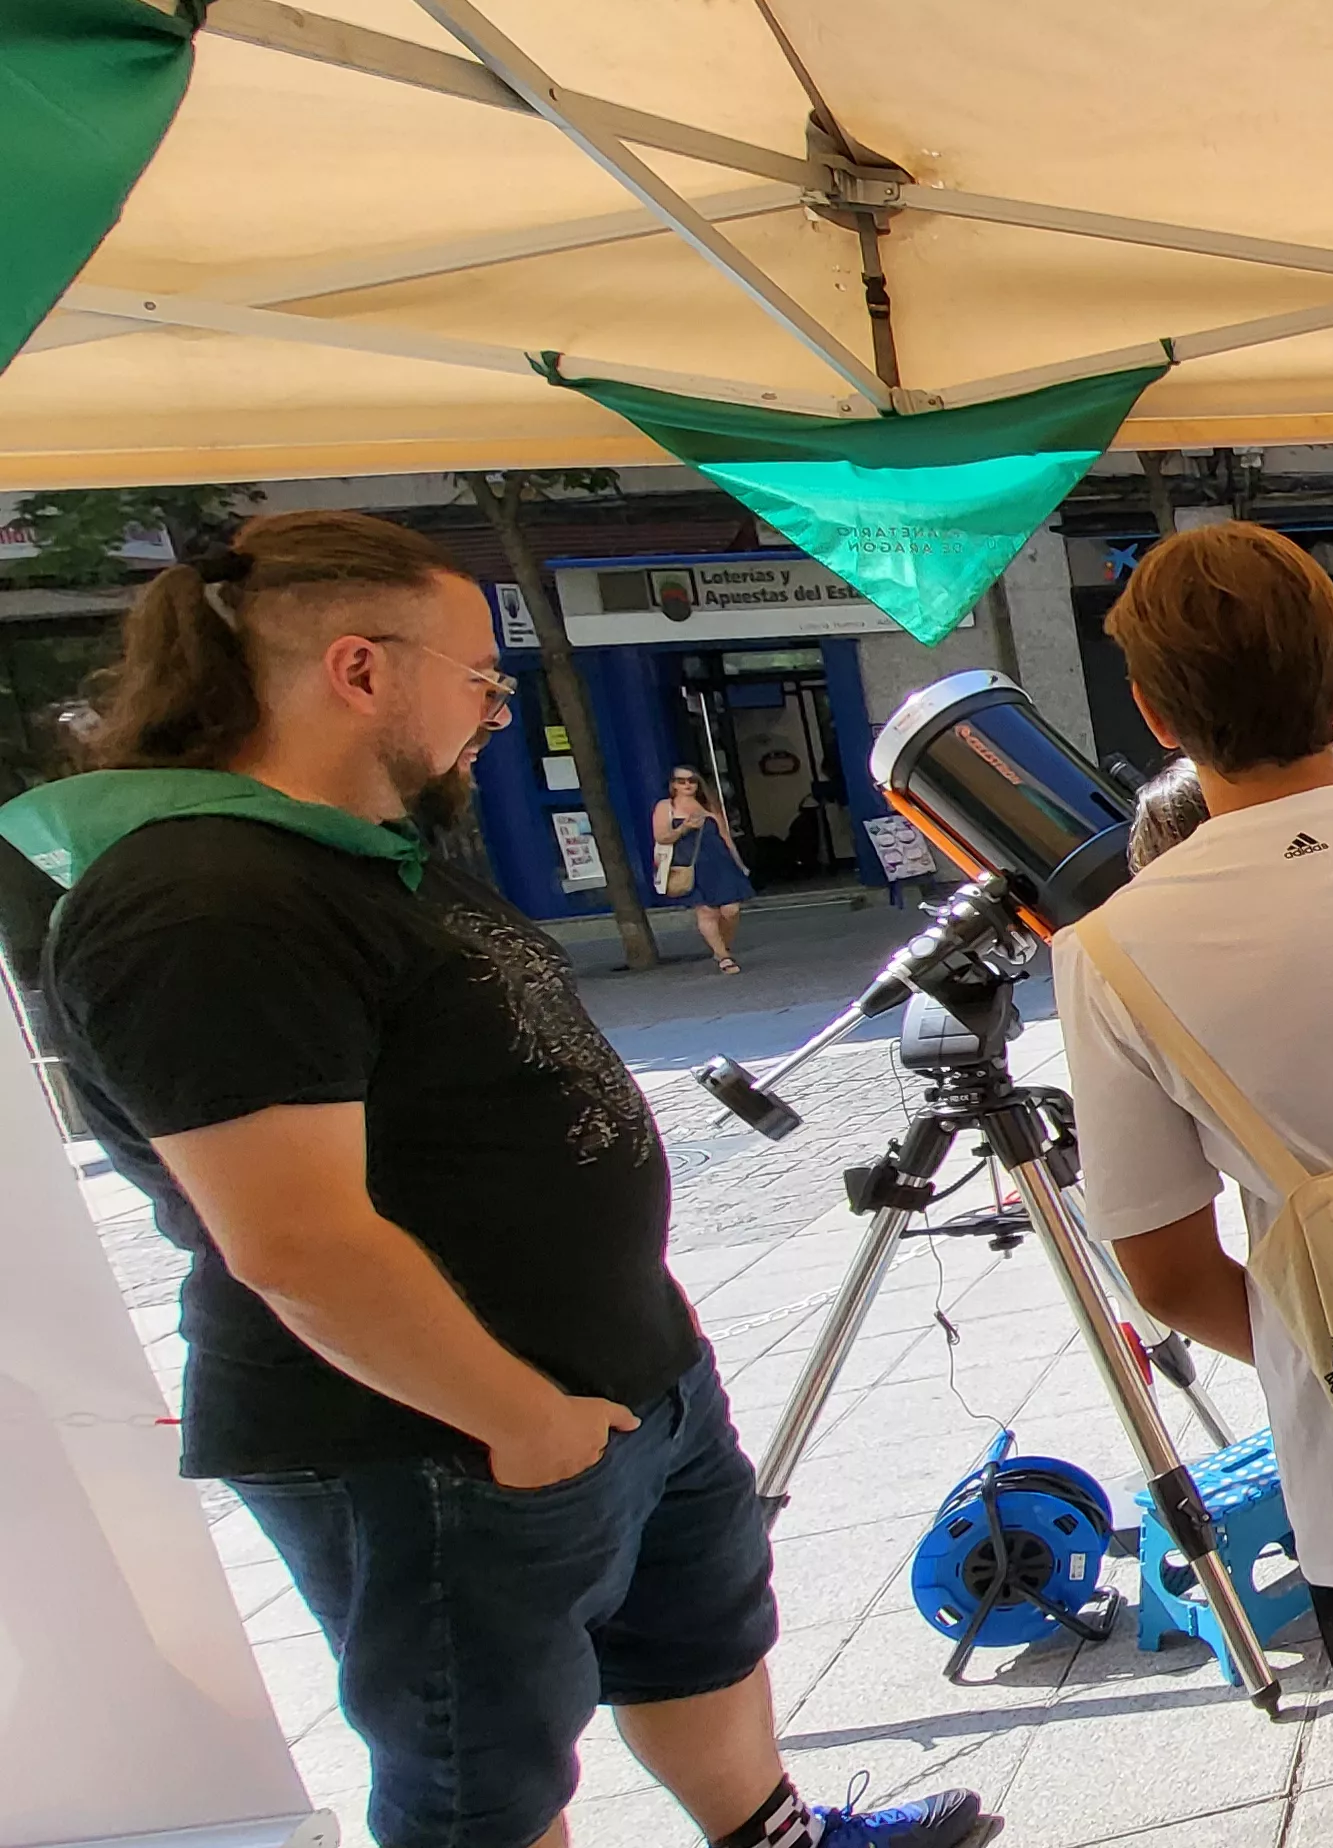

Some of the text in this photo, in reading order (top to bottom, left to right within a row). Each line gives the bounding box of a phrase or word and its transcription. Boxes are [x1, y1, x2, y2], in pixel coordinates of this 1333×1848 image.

[780, 569, 791, 586] y
[705, 584, 867, 608] Apuestas del Est
[1284, 843, 1329, 859] adidas
